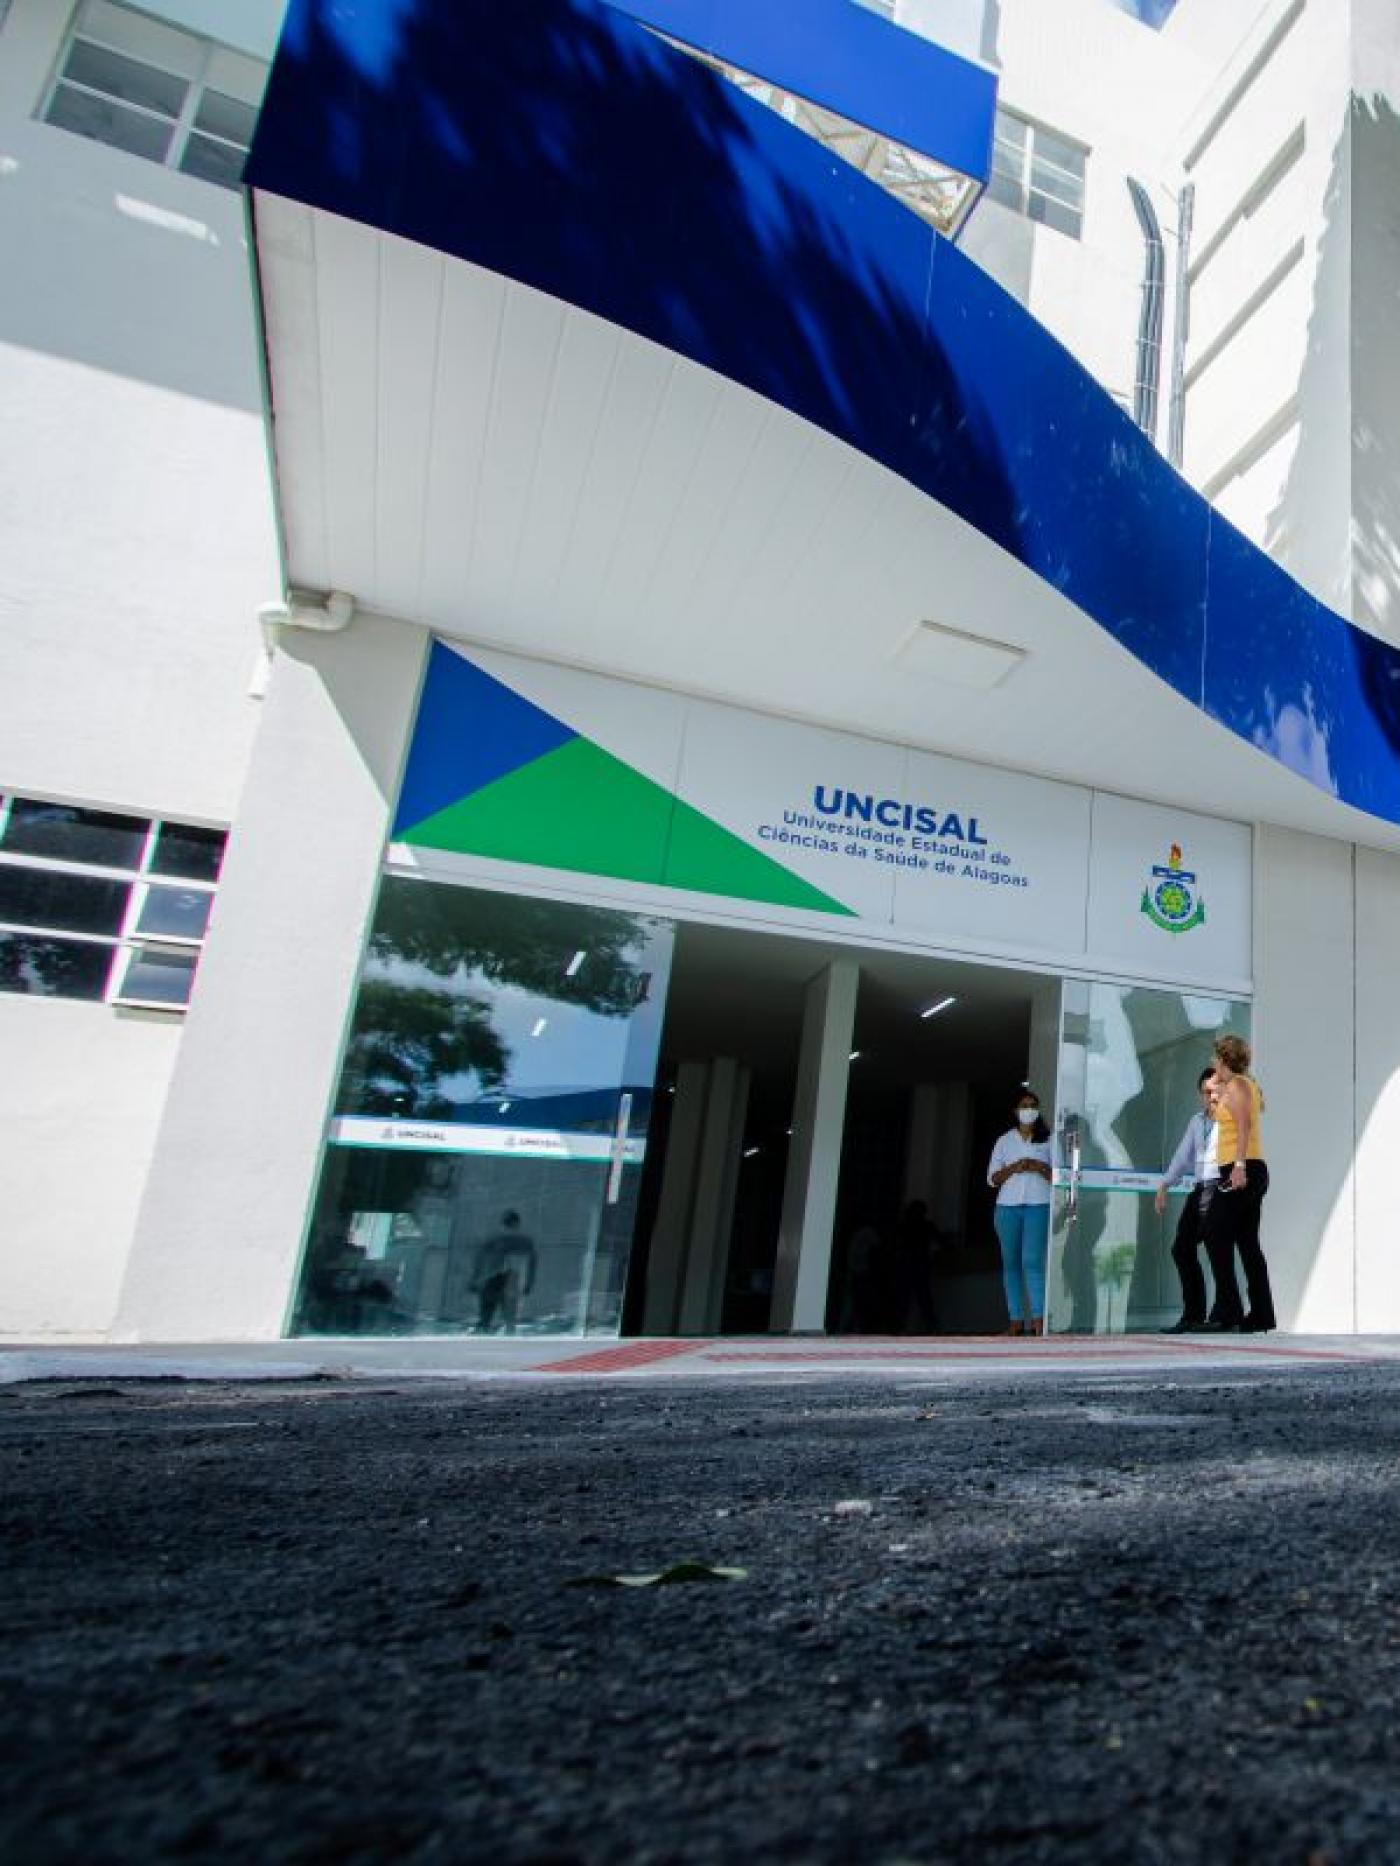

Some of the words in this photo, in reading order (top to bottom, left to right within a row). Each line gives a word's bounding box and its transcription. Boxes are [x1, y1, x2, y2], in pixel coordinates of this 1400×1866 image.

[783, 809, 906, 847] Universidade
[912, 837, 985, 861] Estadual
[991, 850, 1011, 866] de
[815, 785, 988, 845] UNCISAL
[758, 824, 838, 852] Ciências
[844, 842, 867, 859] da
[874, 848, 929, 870] Saúde
[935, 860, 955, 873] de
[961, 864, 1028, 887] Alagoas
